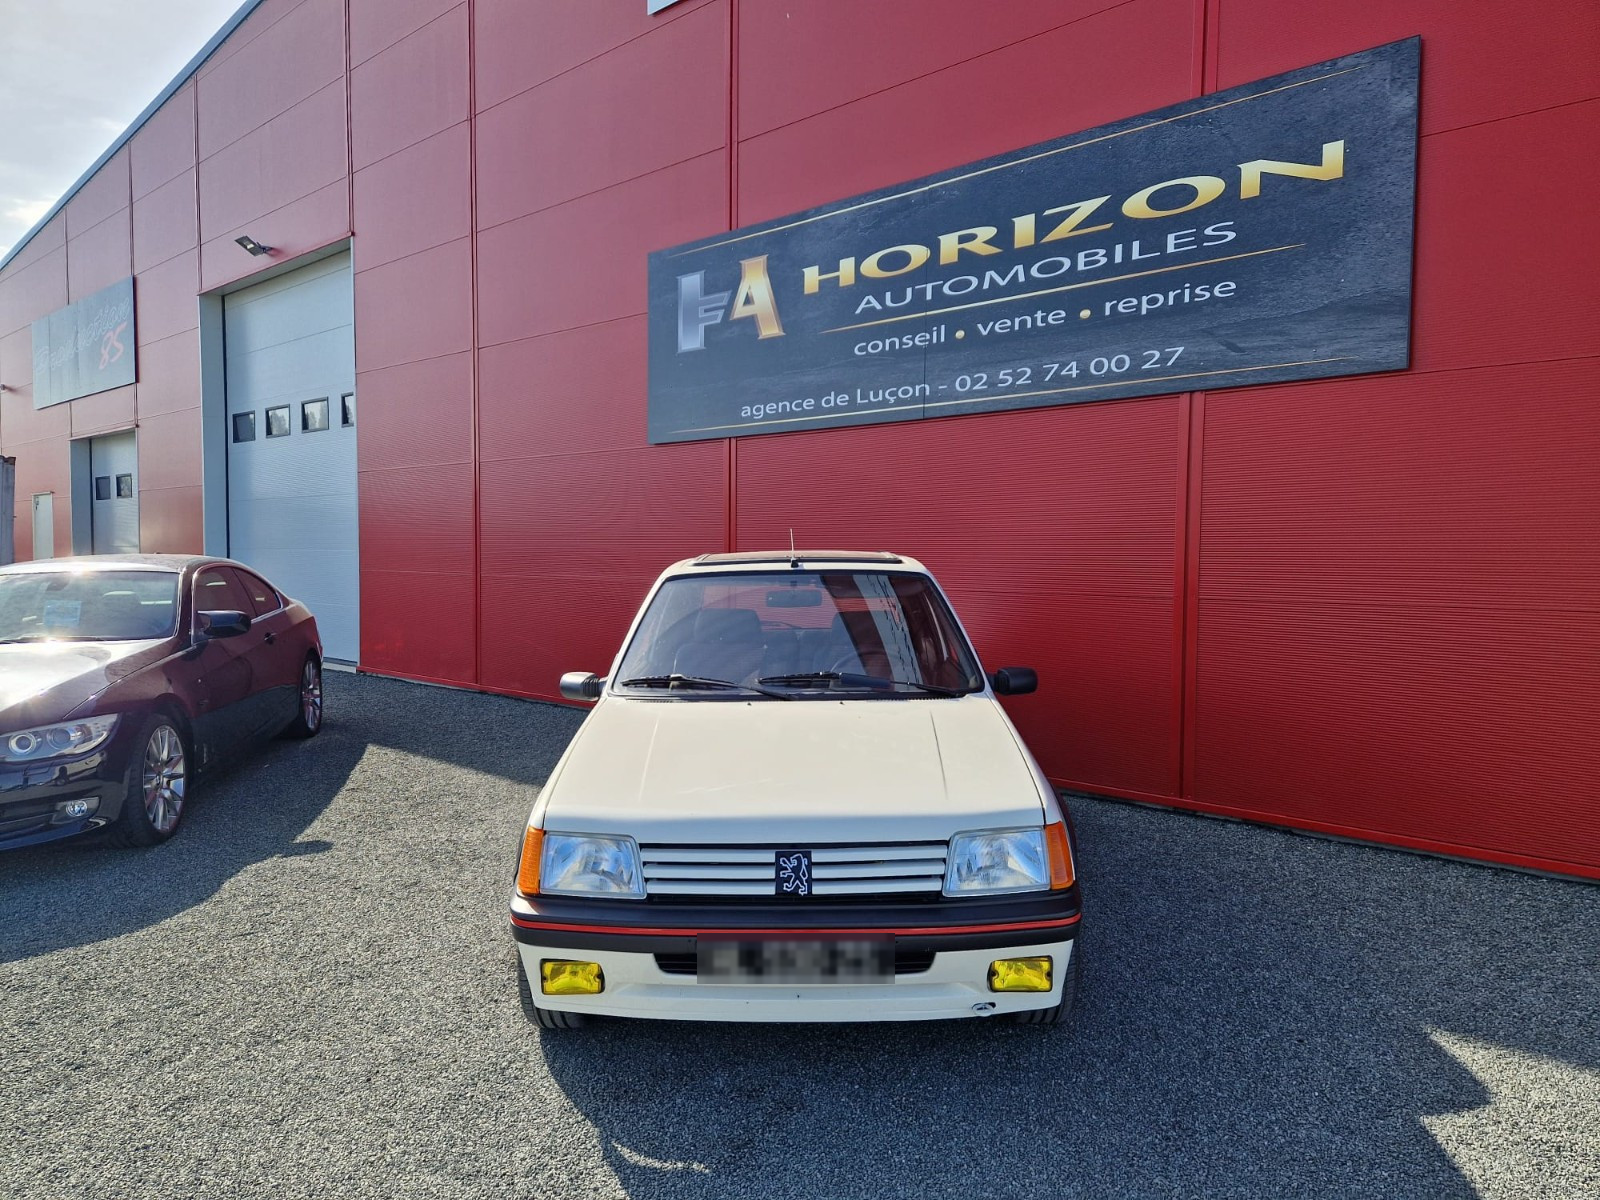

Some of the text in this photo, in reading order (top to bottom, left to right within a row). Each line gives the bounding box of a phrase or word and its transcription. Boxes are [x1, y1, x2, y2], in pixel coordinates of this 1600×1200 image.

[802, 138, 1346, 295] HORIZON
[853, 221, 1238, 314] AUTOMOBILES
[853, 279, 1238, 356] conseil vente reprise
[740, 397, 815, 418] agence
[821, 391, 850, 408] de
[855, 381, 931, 404] Luçon
[954, 373, 988, 392] 02
[997, 366, 1033, 386] 52
[1042, 361, 1081, 382] 74
[1089, 353, 1131, 376] 00
[1141, 345, 1186, 368] 27
